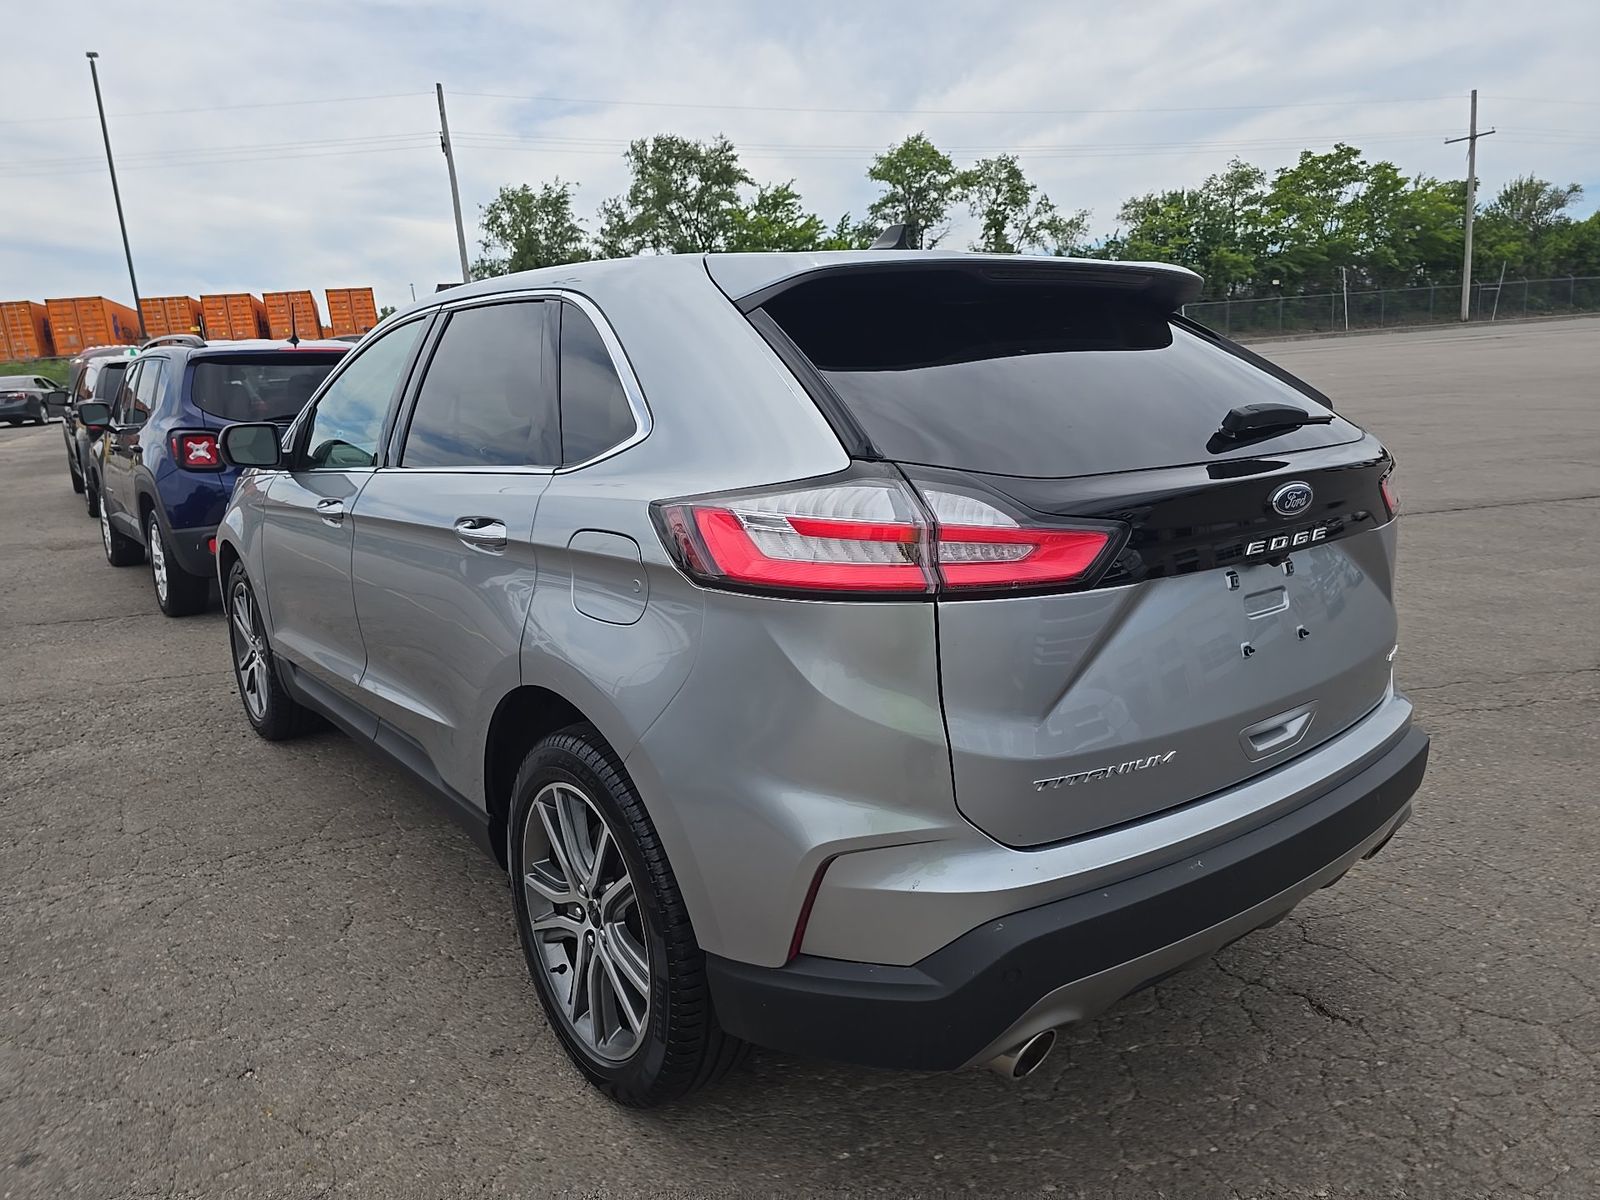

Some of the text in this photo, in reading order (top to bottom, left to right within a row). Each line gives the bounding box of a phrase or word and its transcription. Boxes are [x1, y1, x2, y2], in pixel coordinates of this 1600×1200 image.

[1284, 490, 1307, 510] Ford
[1246, 526, 1328, 556] EDGE
[1033, 750, 1177, 791] TITANIUM
